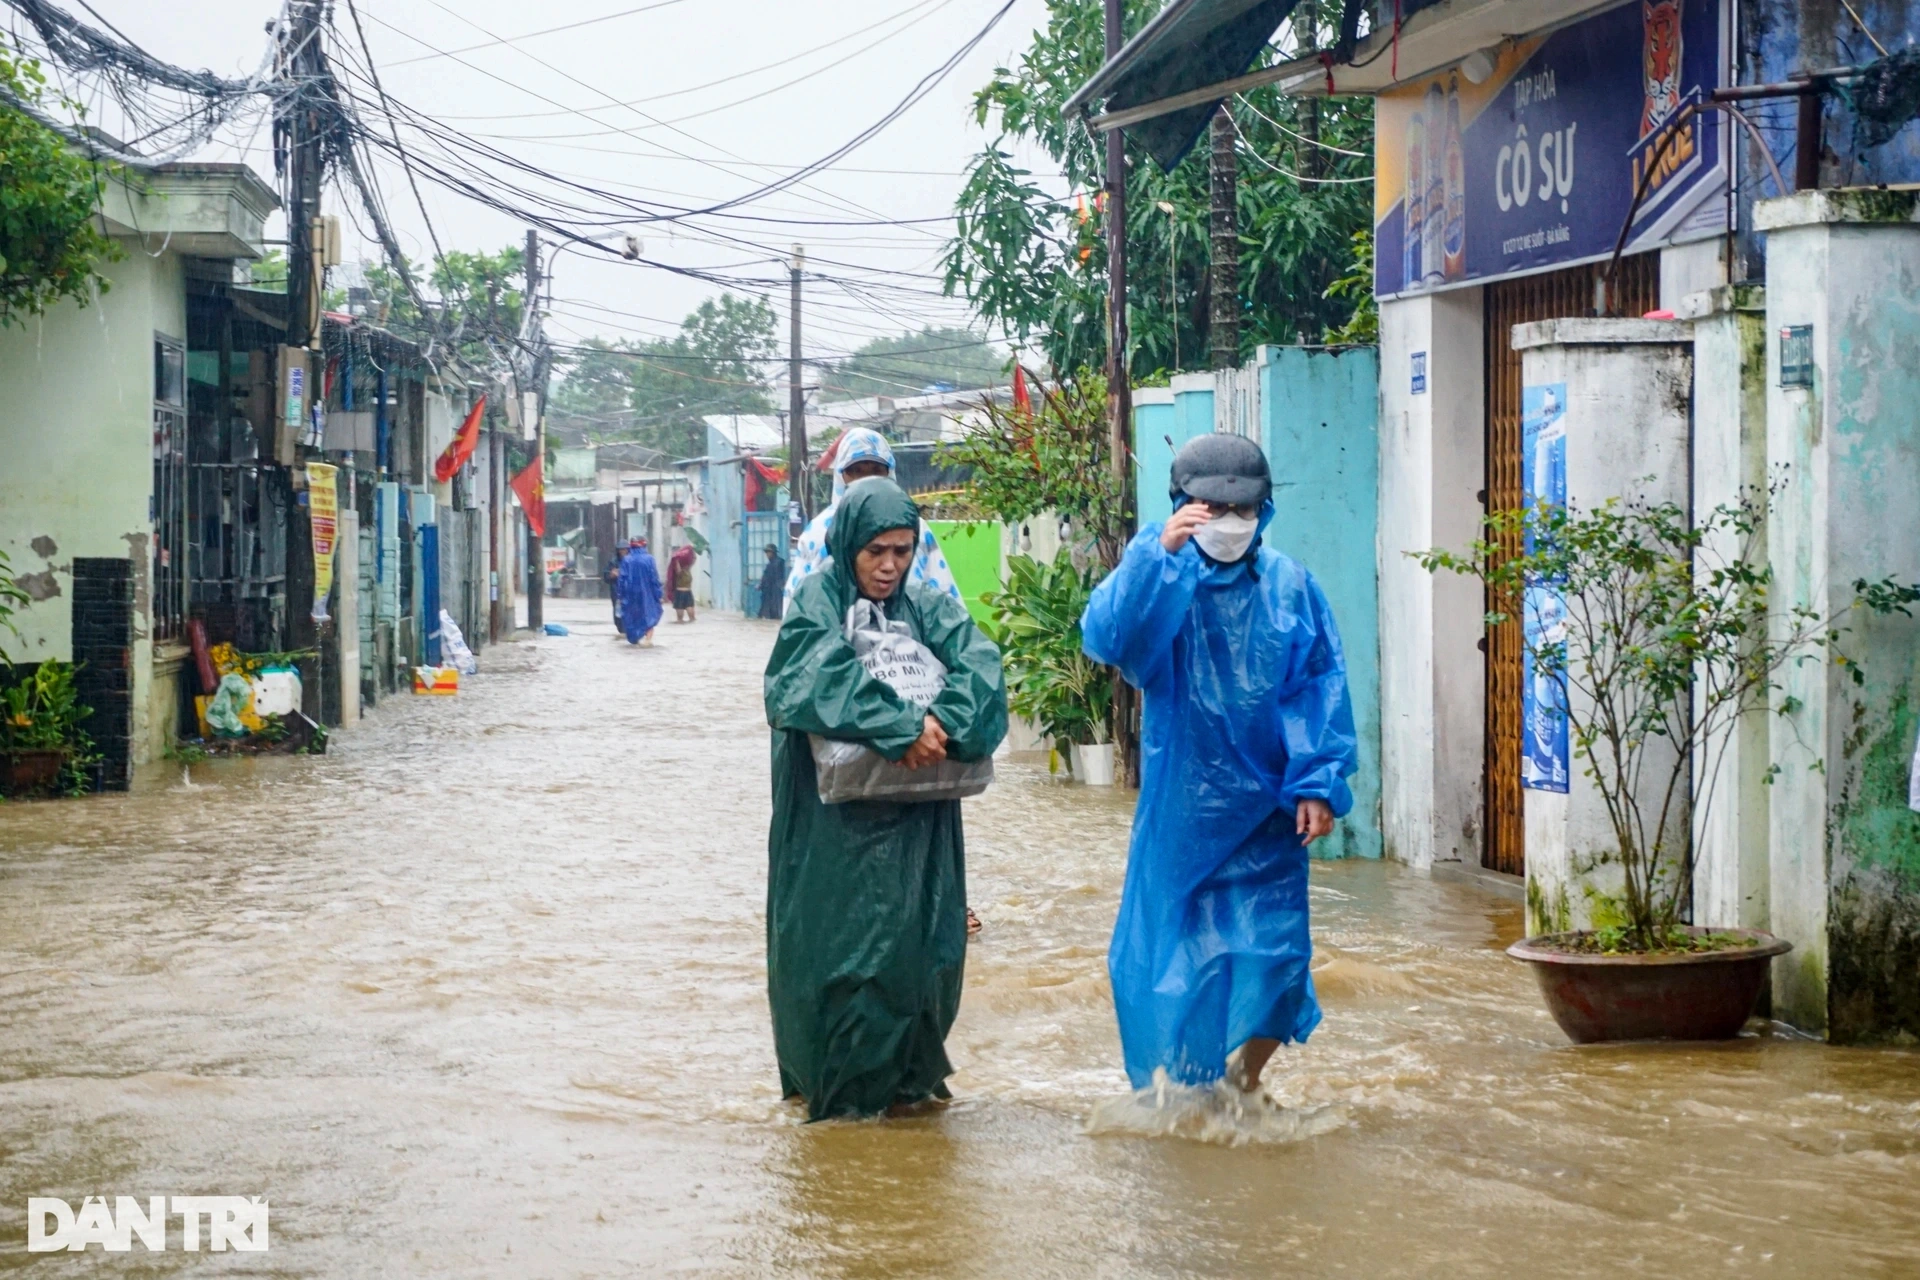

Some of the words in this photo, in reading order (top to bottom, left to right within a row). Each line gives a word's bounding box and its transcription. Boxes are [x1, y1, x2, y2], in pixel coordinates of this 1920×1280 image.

[1514, 77, 1532, 115] TẠP
[1496, 123, 1532, 212] CÔ
[1538, 121, 1577, 215] SỰ
[874, 666, 898, 681] Bé
